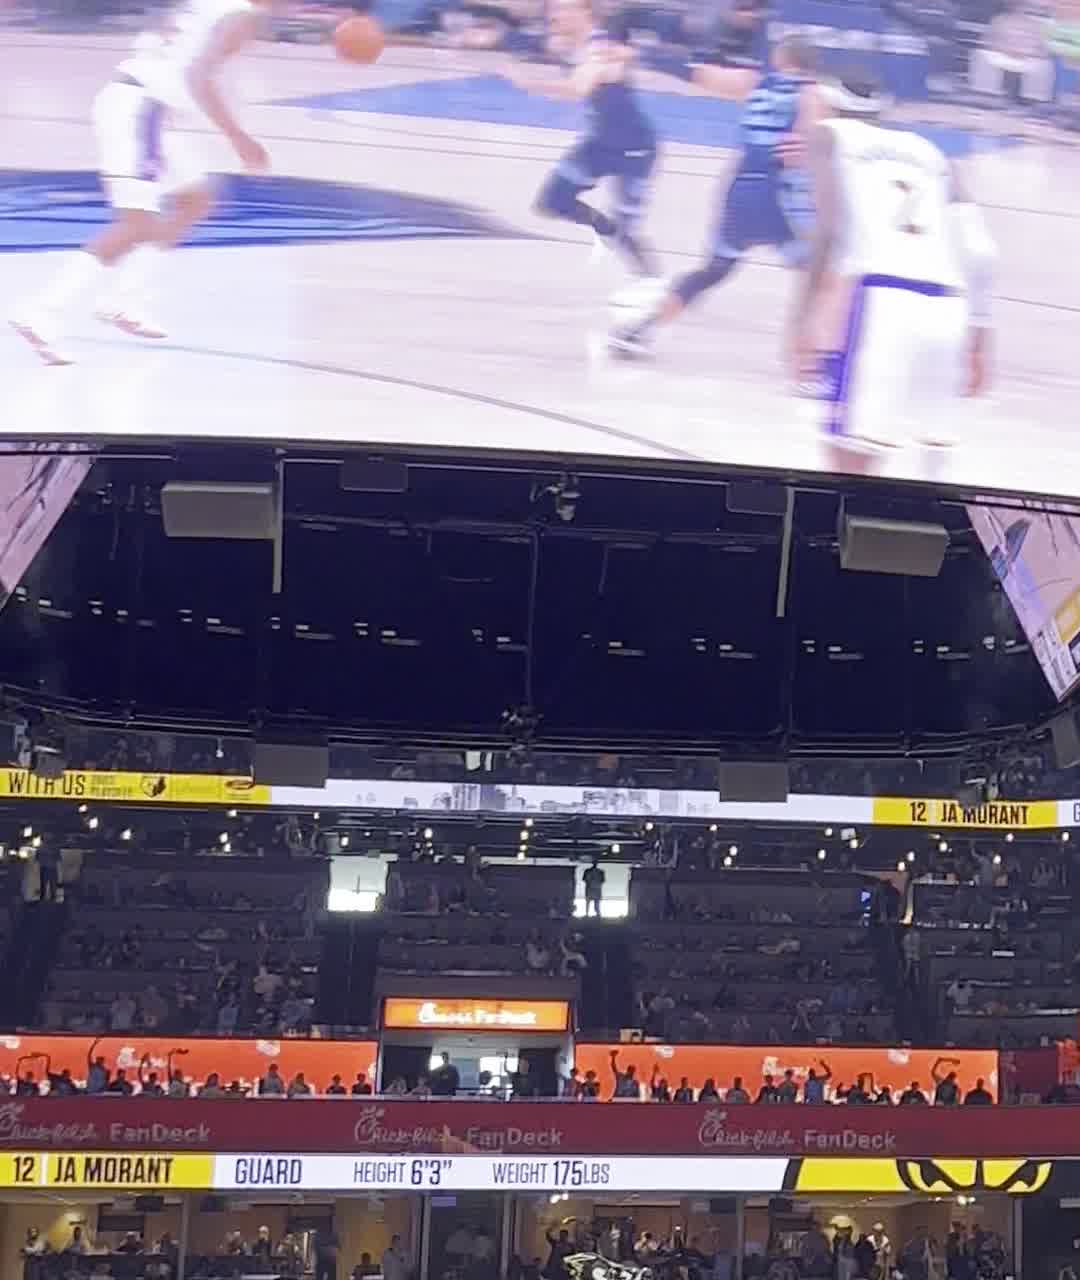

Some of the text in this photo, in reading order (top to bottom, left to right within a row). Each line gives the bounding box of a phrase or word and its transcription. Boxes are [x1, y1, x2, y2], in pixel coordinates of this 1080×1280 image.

[62, 774, 86, 796] US
[910, 802, 927, 821] 12
[941, 802, 961, 822] JA
[109, 1121, 210, 1143] FanDeck
[464, 1125, 565, 1147] FanDeck
[804, 1128, 896, 1150] FanDeck
[13, 1156, 34, 1183] 12
[54, 1156, 77, 1183] JA
[83, 1156, 174, 1183] MORANT
[234, 1157, 302, 1185] GUARD
[353, 1161, 407, 1184] HEIGHT
[492, 1162, 550, 1185] WEIGHT
